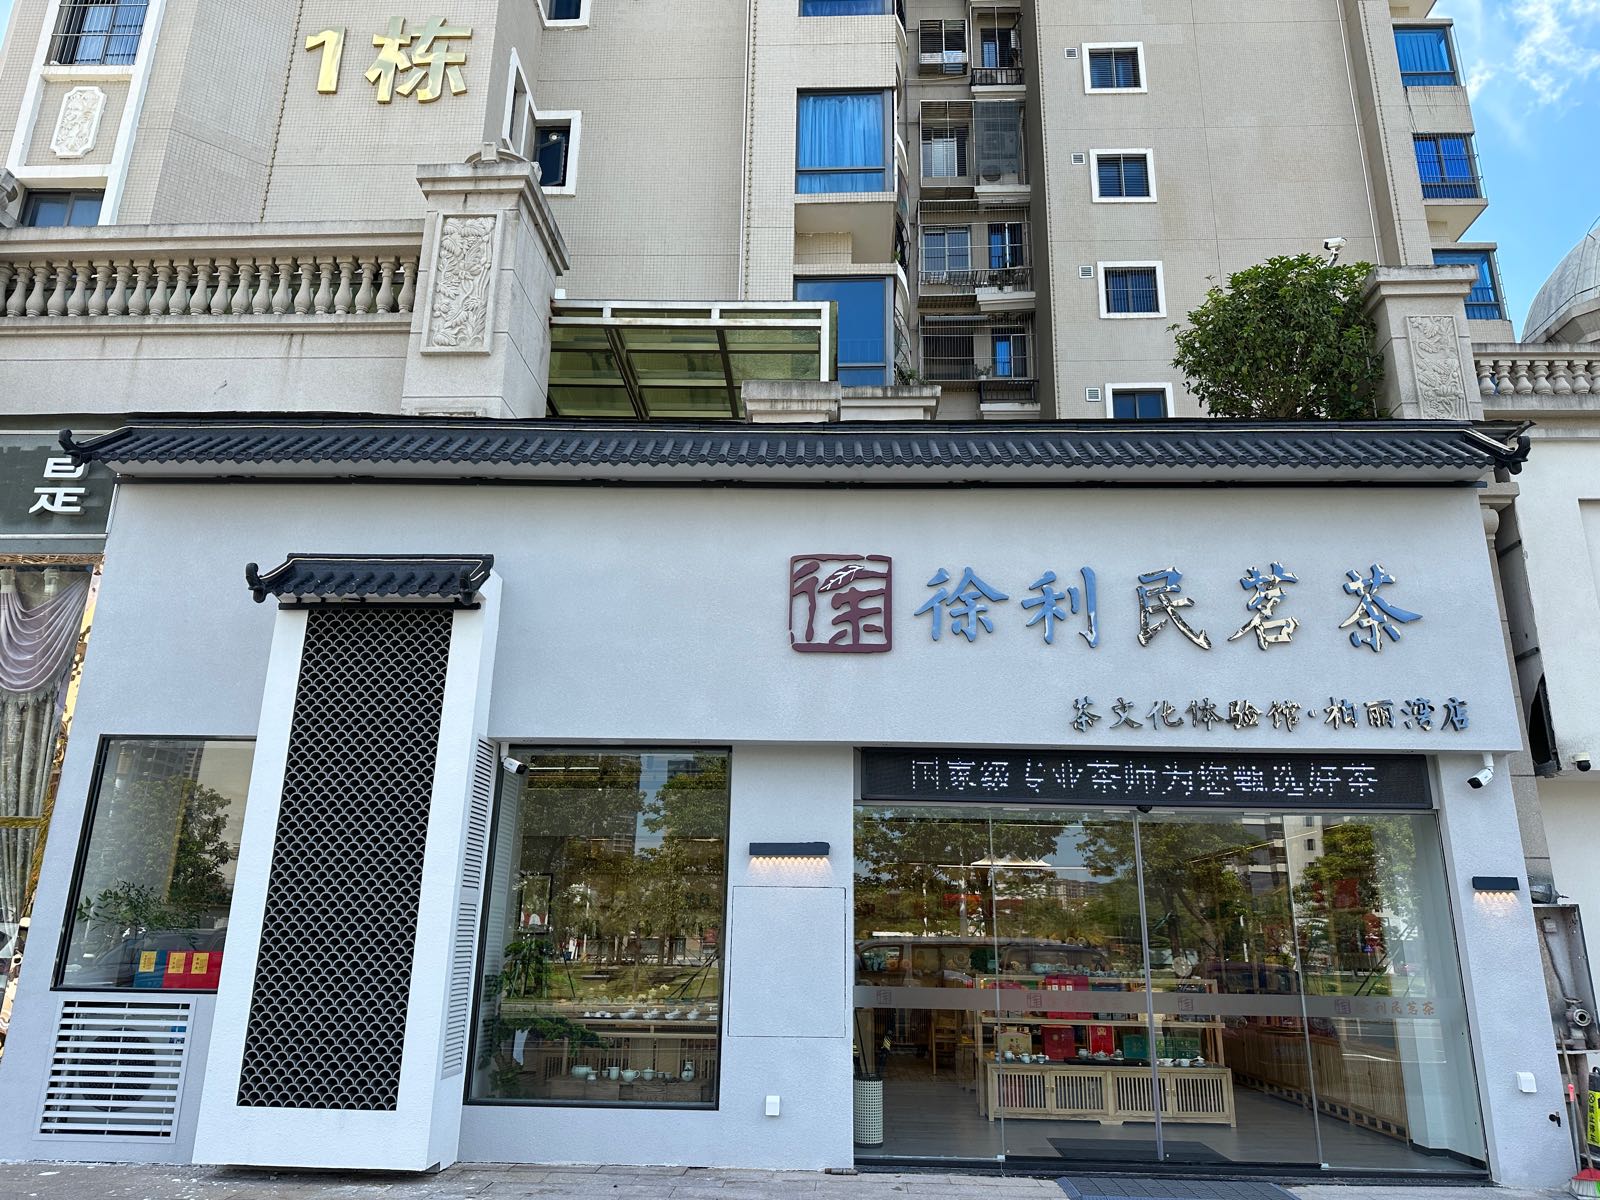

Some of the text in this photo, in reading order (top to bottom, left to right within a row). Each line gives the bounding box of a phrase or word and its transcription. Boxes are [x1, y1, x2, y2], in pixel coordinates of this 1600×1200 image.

[305, 15, 472, 104] 1栋
[914, 562, 1423, 652] 徐利民茗茶
